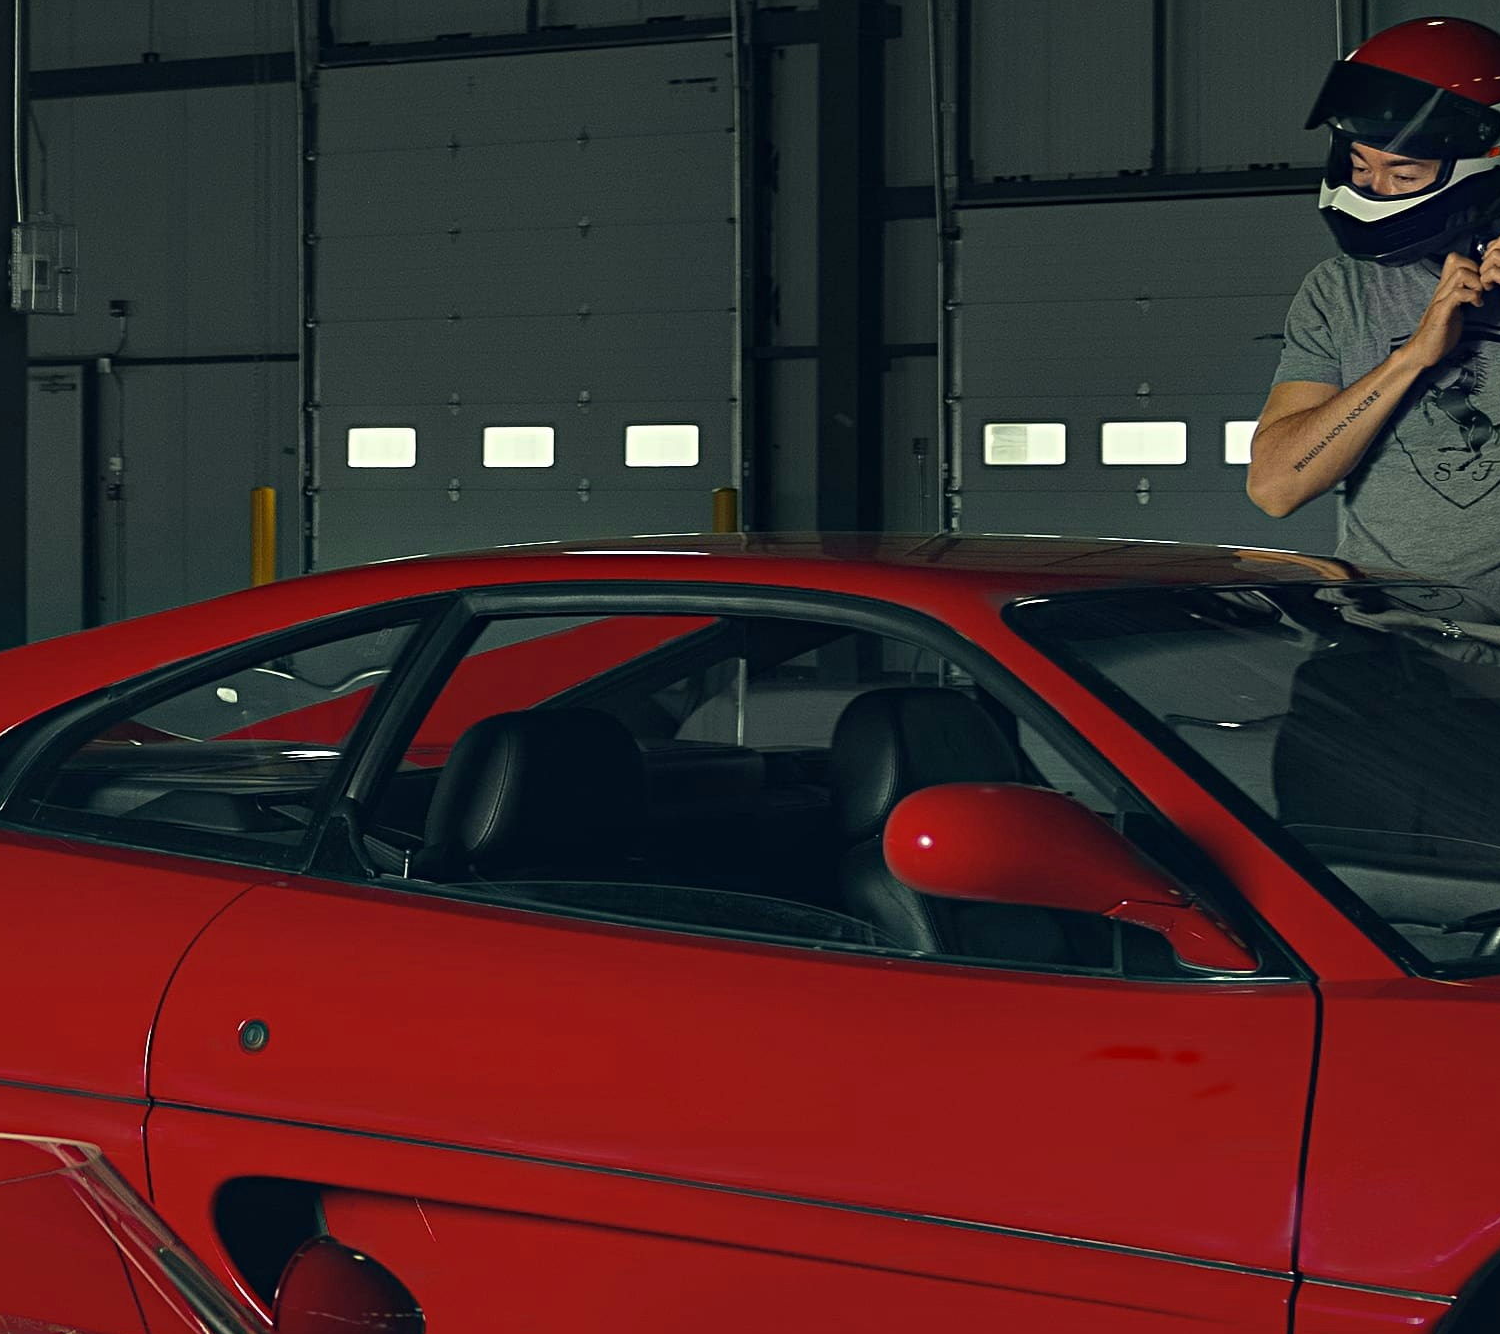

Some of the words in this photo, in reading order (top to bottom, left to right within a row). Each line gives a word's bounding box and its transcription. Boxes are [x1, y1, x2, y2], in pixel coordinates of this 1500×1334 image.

[1293, 441, 1328, 472] PRIMUM
[1325, 421, 1348, 443] NON
[1345, 390, 1381, 423] NOCERE
[1434, 462, 1451, 482] S
